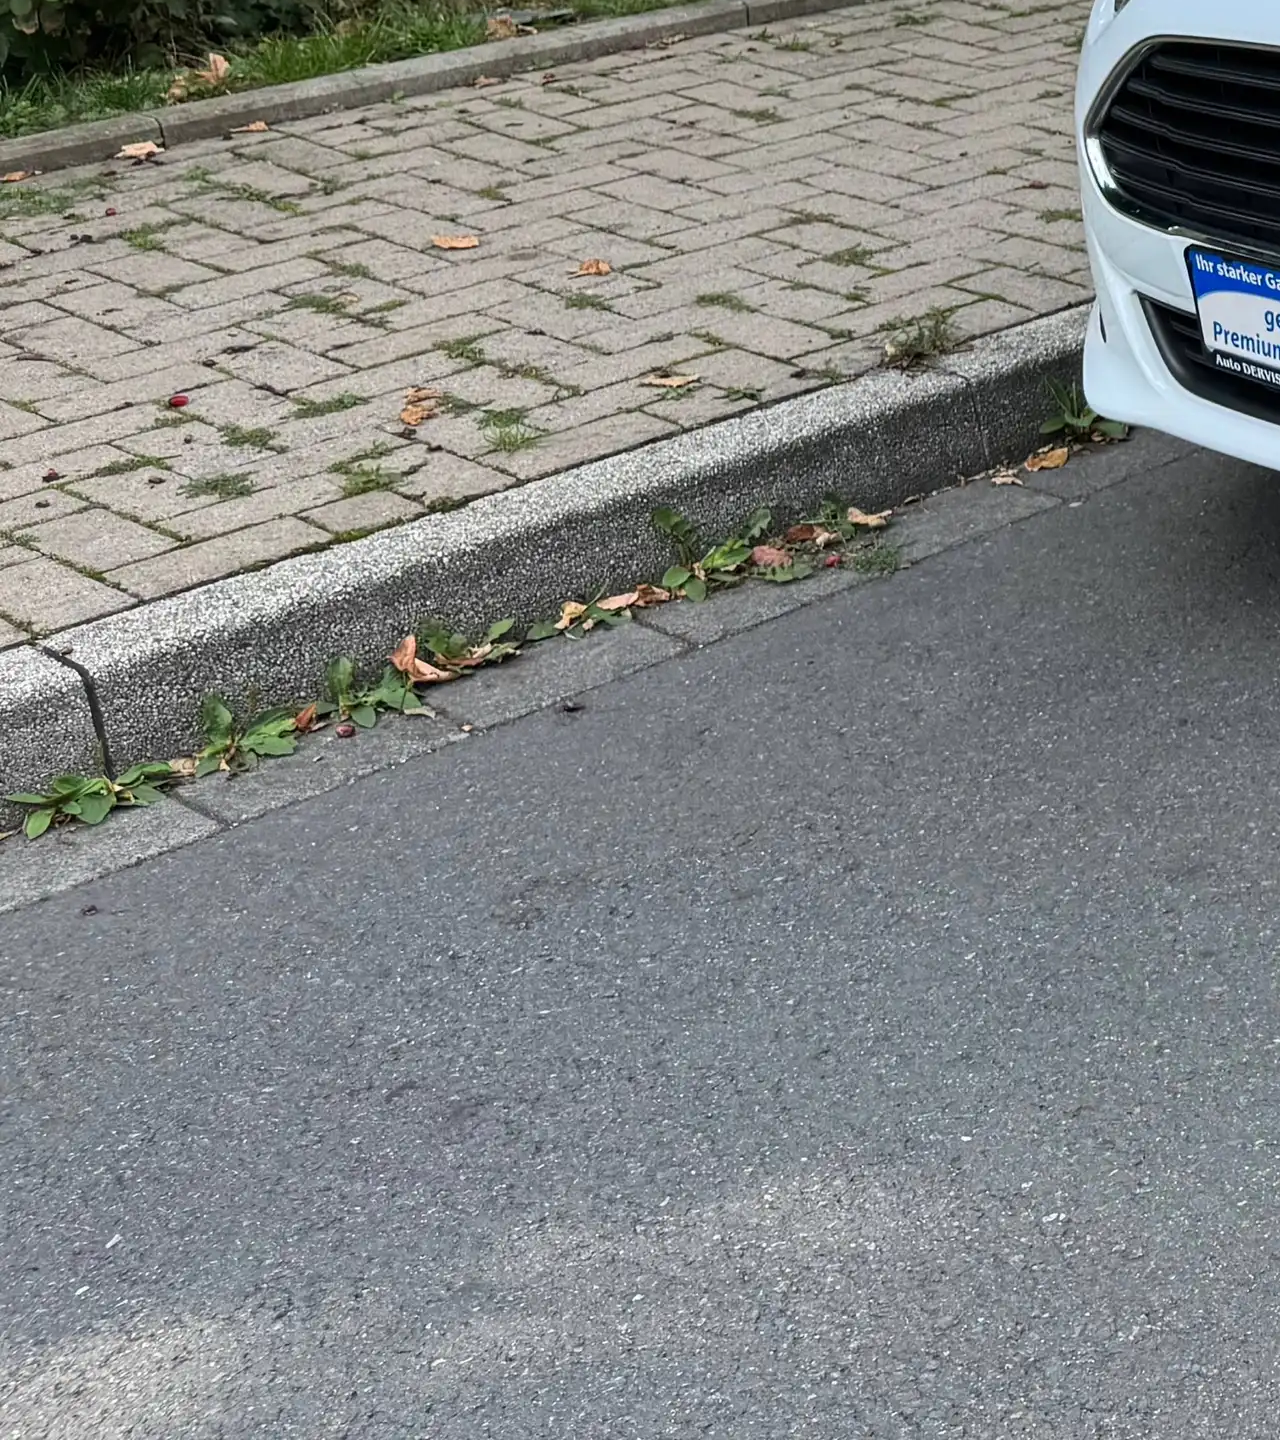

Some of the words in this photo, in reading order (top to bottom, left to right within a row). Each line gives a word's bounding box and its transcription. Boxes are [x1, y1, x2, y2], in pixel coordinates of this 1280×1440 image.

[1195, 254, 1214, 273] Ihr
[1217, 262, 1263, 287] starker
[1216, 353, 1241, 372] Auto
